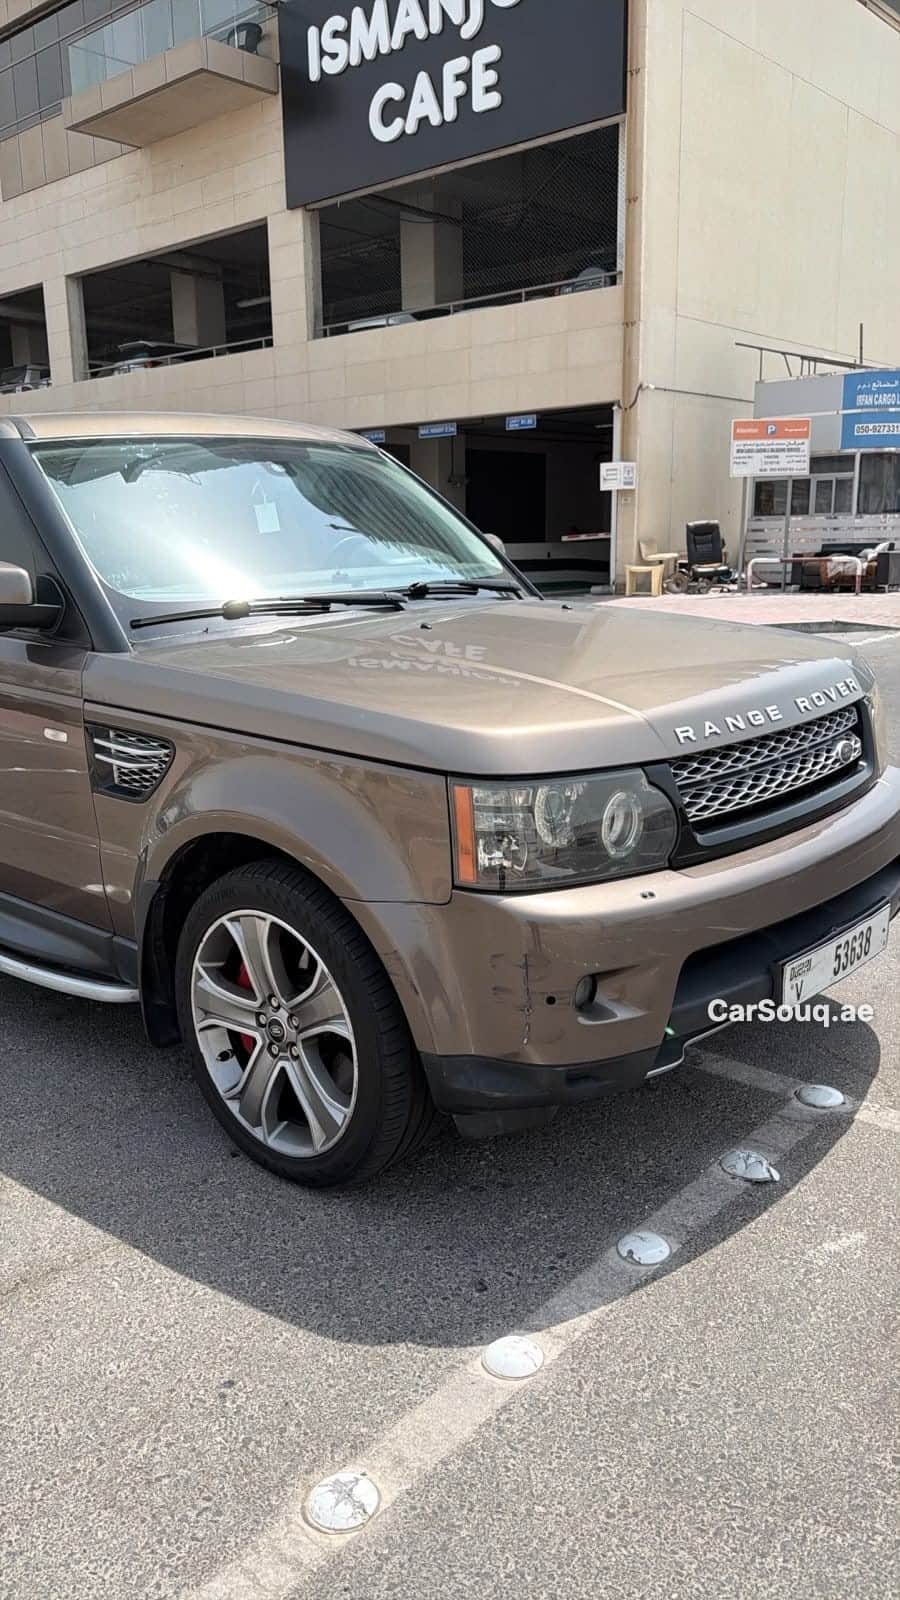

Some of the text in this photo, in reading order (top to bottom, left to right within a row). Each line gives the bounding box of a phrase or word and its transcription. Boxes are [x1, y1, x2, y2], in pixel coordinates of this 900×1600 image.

[307, 0, 523, 82] ISMANJ
[368, 44, 502, 143] CAFE
[873, 393, 897, 405] CARGO
[767, 424, 777, 435] P
[674, 677, 858, 744] RANGE ROVER
[833, 925, 873, 976] 53638
[794, 979, 804, 1001] V
